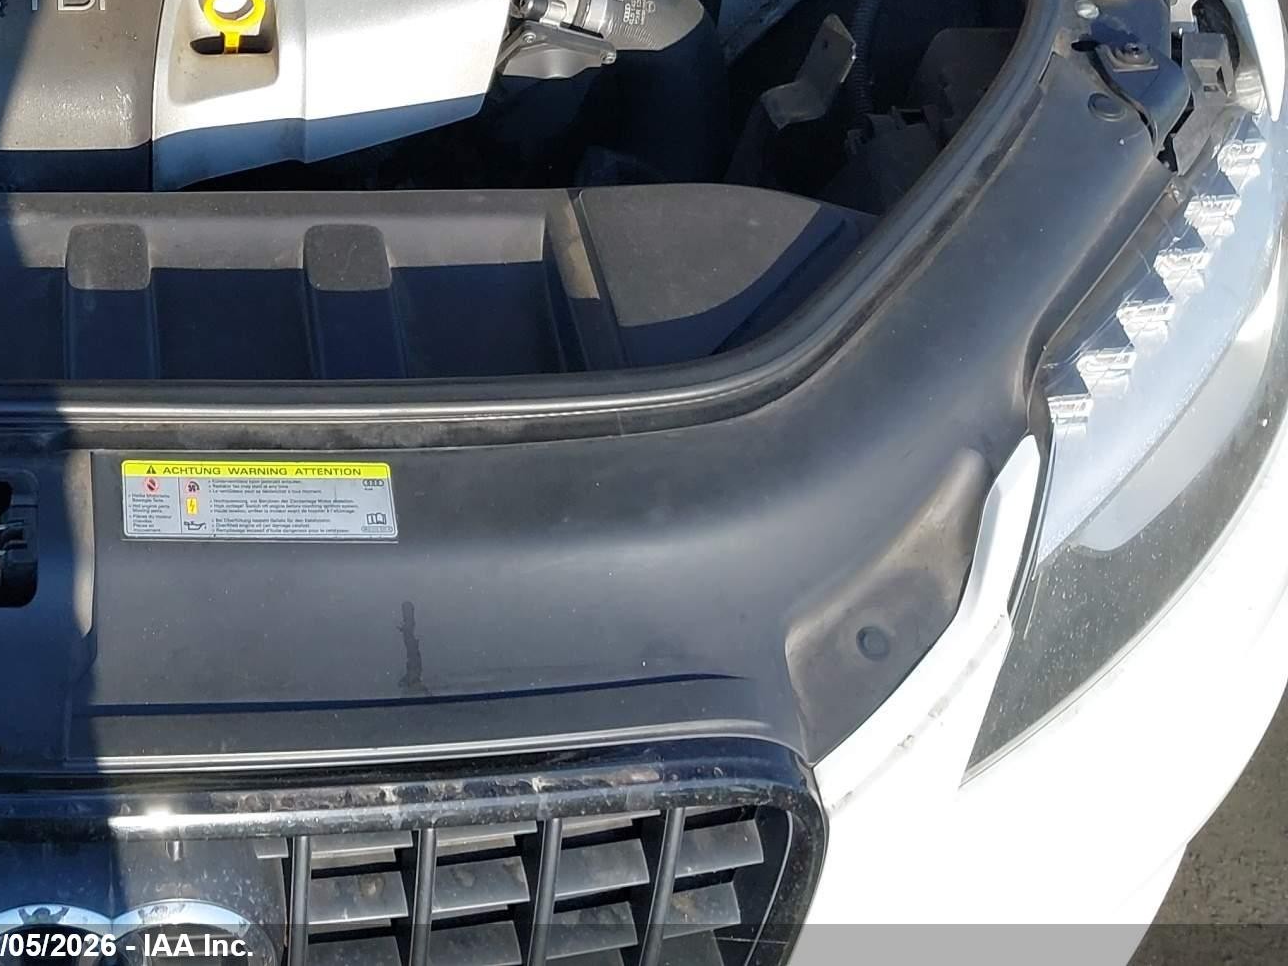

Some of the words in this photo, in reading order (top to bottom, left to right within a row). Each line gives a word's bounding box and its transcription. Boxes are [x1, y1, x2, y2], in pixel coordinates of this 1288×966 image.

[163, 466, 221, 476] ACHTUNG
[227, 467, 291, 476] WARNING
[295, 467, 361, 477] ATTENTION
